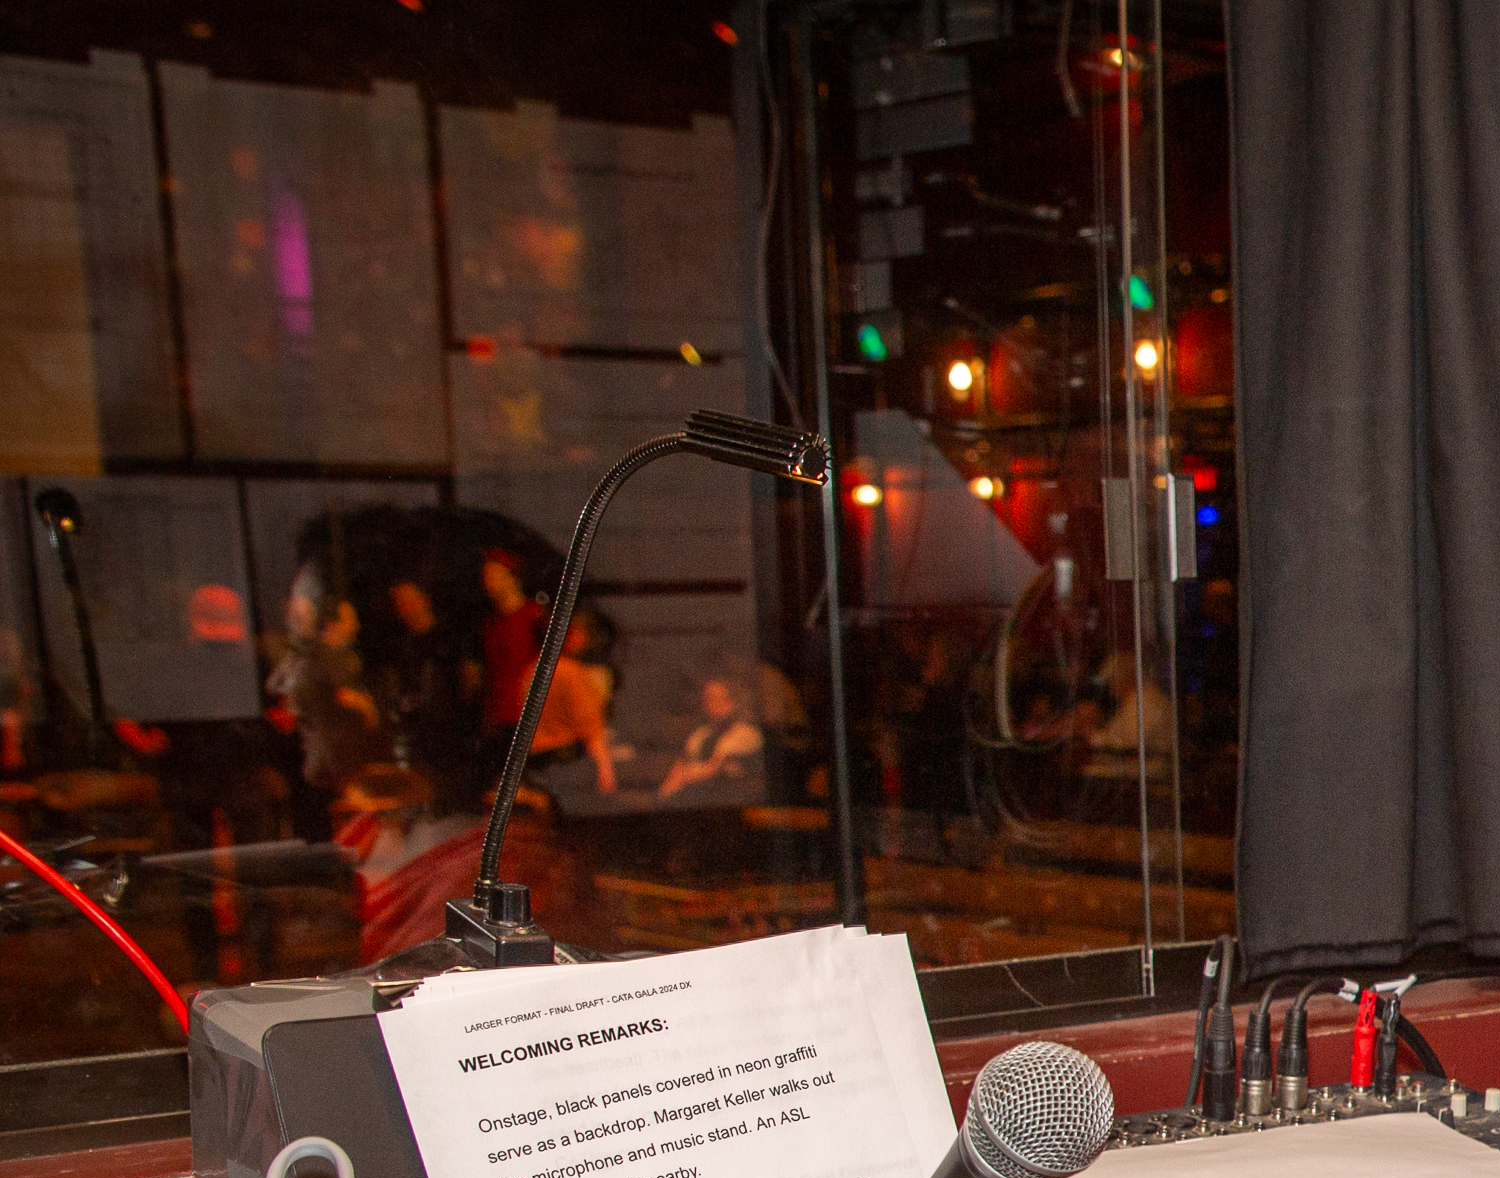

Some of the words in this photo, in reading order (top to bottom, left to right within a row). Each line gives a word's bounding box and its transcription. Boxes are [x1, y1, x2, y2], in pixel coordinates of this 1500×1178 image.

[464, 1019, 503, 1033] LARGER
[504, 1011, 541, 1024] FORMAT
[549, 1005, 574, 1016] FINAL
[576, 998, 604, 1010] DRAFT
[612, 993, 634, 1003] CATA
[635, 988, 658, 998] GALA
[659, 984, 678, 994] 2024
[680, 981, 692, 989] DX
[458, 1037, 573, 1073] WELCOMING
[577, 1018, 668, 1048] REMARKS:
[478, 1109, 552, 1133] Onstage,
[555, 1095, 598, 1116] black
[602, 1084, 652, 1108] panels
[656, 1068, 714, 1092] covered
[718, 1066, 732, 1078] in
[736, 1058, 771, 1074] neon
[775, 1045, 817, 1068] graffiti
[488, 1145, 532, 1163] serve
[537, 1139, 556, 1152] as
[560, 1136, 571, 1146] a
[574, 1118, 650, 1143] backdrop.
[654, 1098, 721, 1124] Margaret
[724, 1089, 765, 1107] Keller
[769, 1079, 809, 1096] walks
[813, 1071, 835, 1086] out
[628, 1143, 656, 1162] and
[660, 1133, 704, 1154] music
[708, 1121, 752, 1142] stand.
[757, 1117, 776, 1130] An
[781, 1107, 810, 1125] ASL
